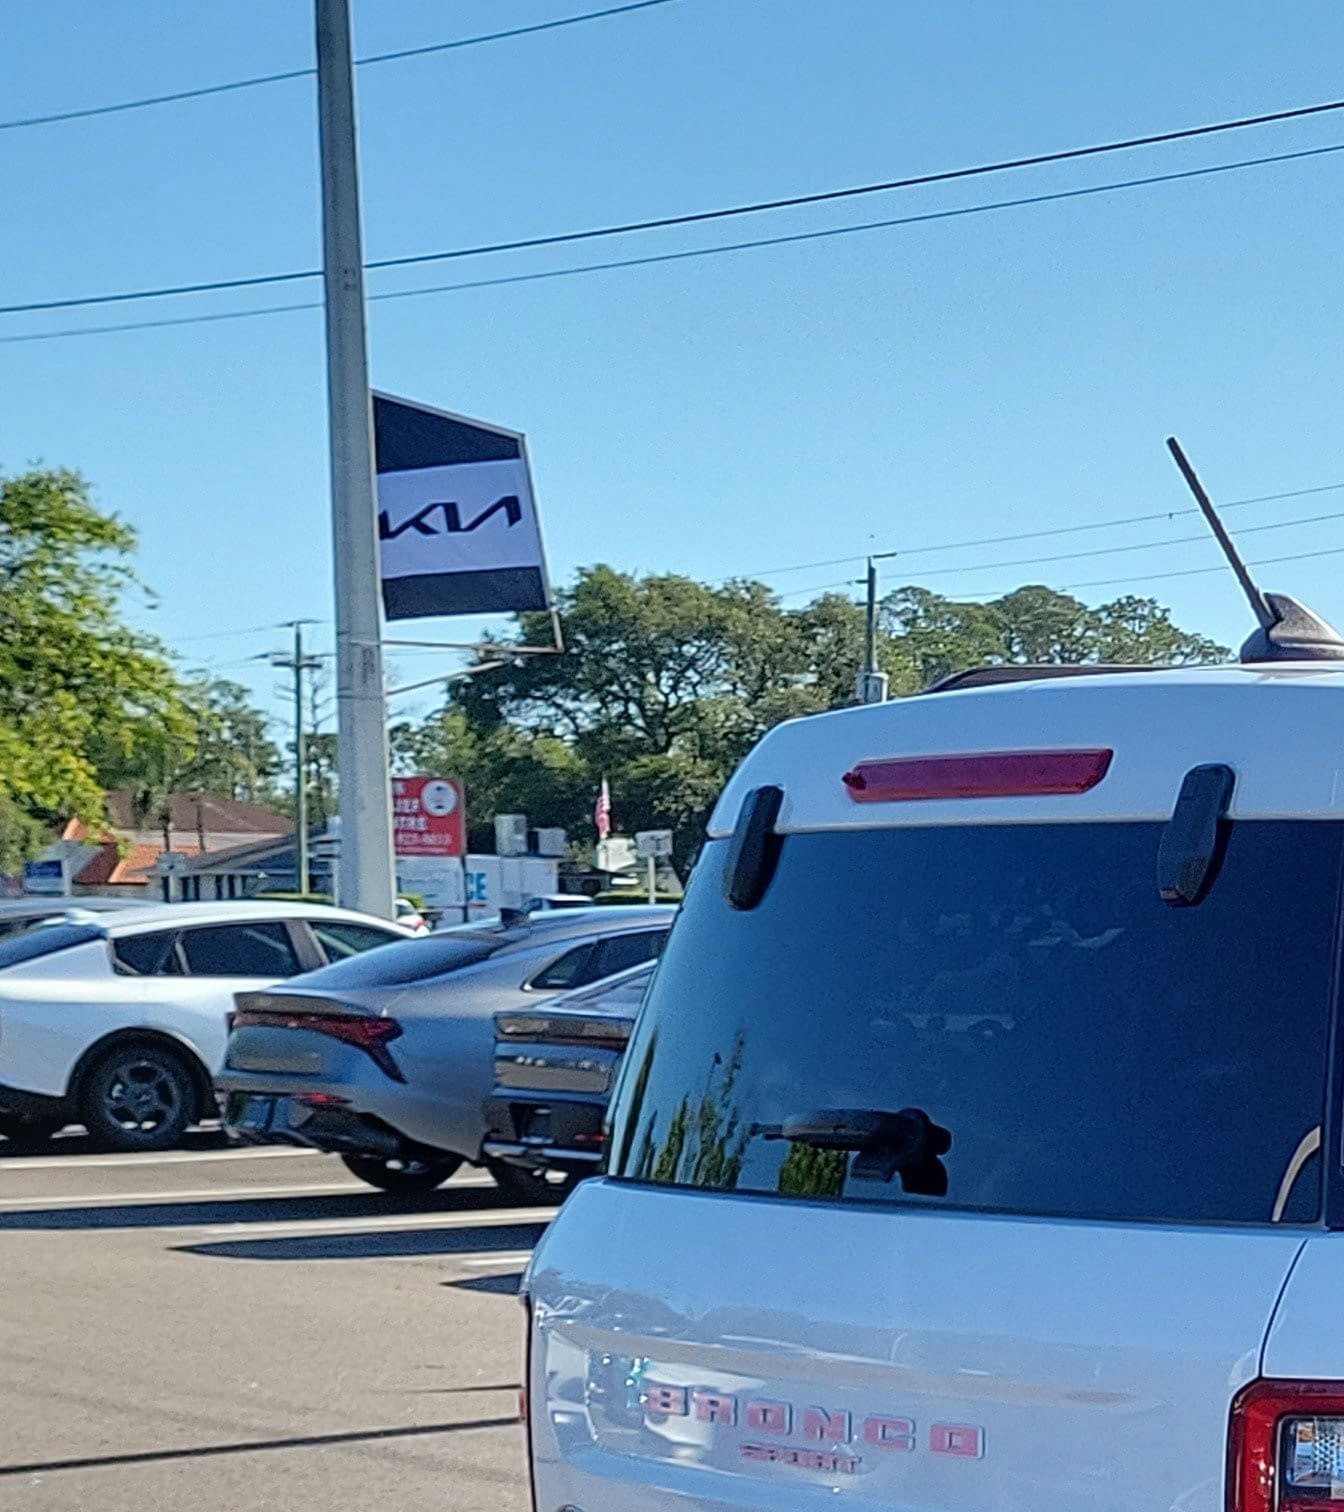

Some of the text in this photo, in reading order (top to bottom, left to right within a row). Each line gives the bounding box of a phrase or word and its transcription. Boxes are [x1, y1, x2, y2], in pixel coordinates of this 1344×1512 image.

[378, 495, 522, 541] KIA
[648, 1384, 985, 1460] BRONCO
[738, 1442, 863, 1474] SPORT
